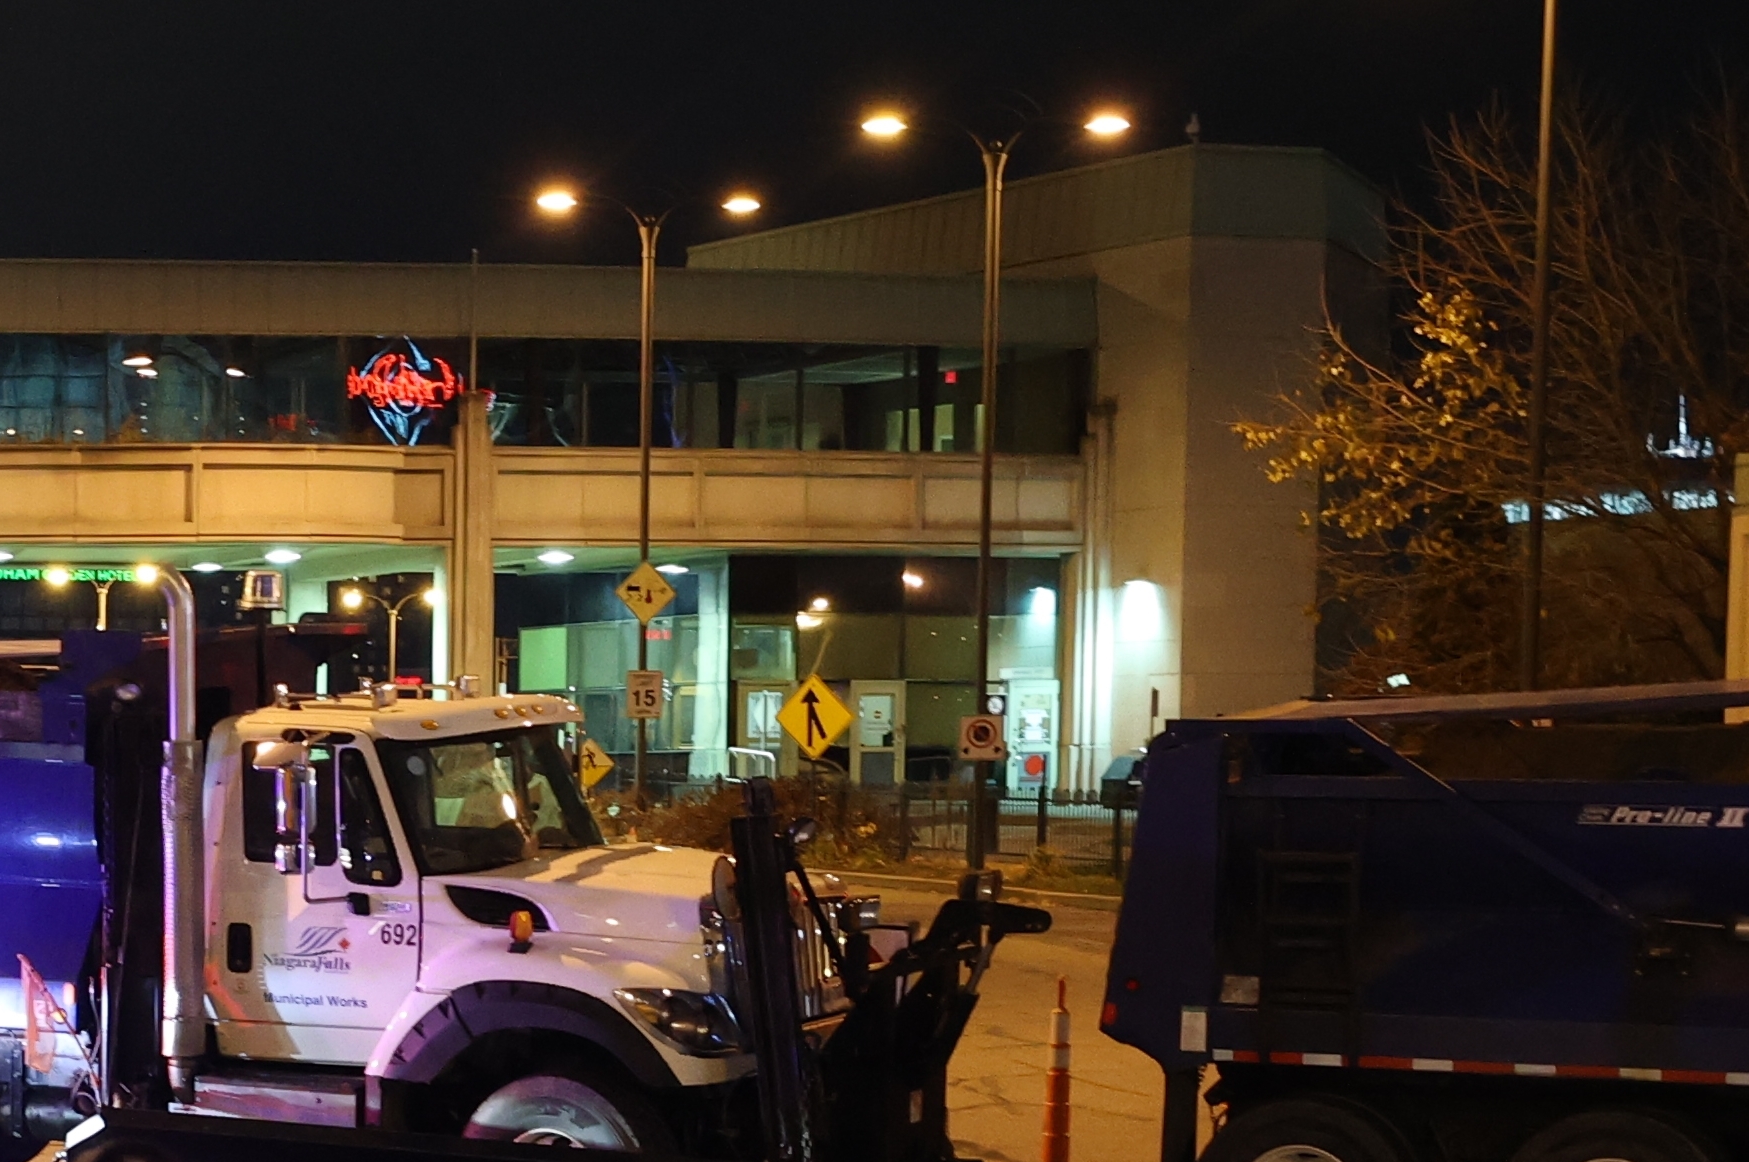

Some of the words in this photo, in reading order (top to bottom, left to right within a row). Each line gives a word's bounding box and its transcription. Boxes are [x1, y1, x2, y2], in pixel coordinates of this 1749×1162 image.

[632, 689, 656, 707] 15
[381, 923, 417, 946] 692
[264, 991, 324, 1006] Municipal
[326, 996, 368, 1009] Works
